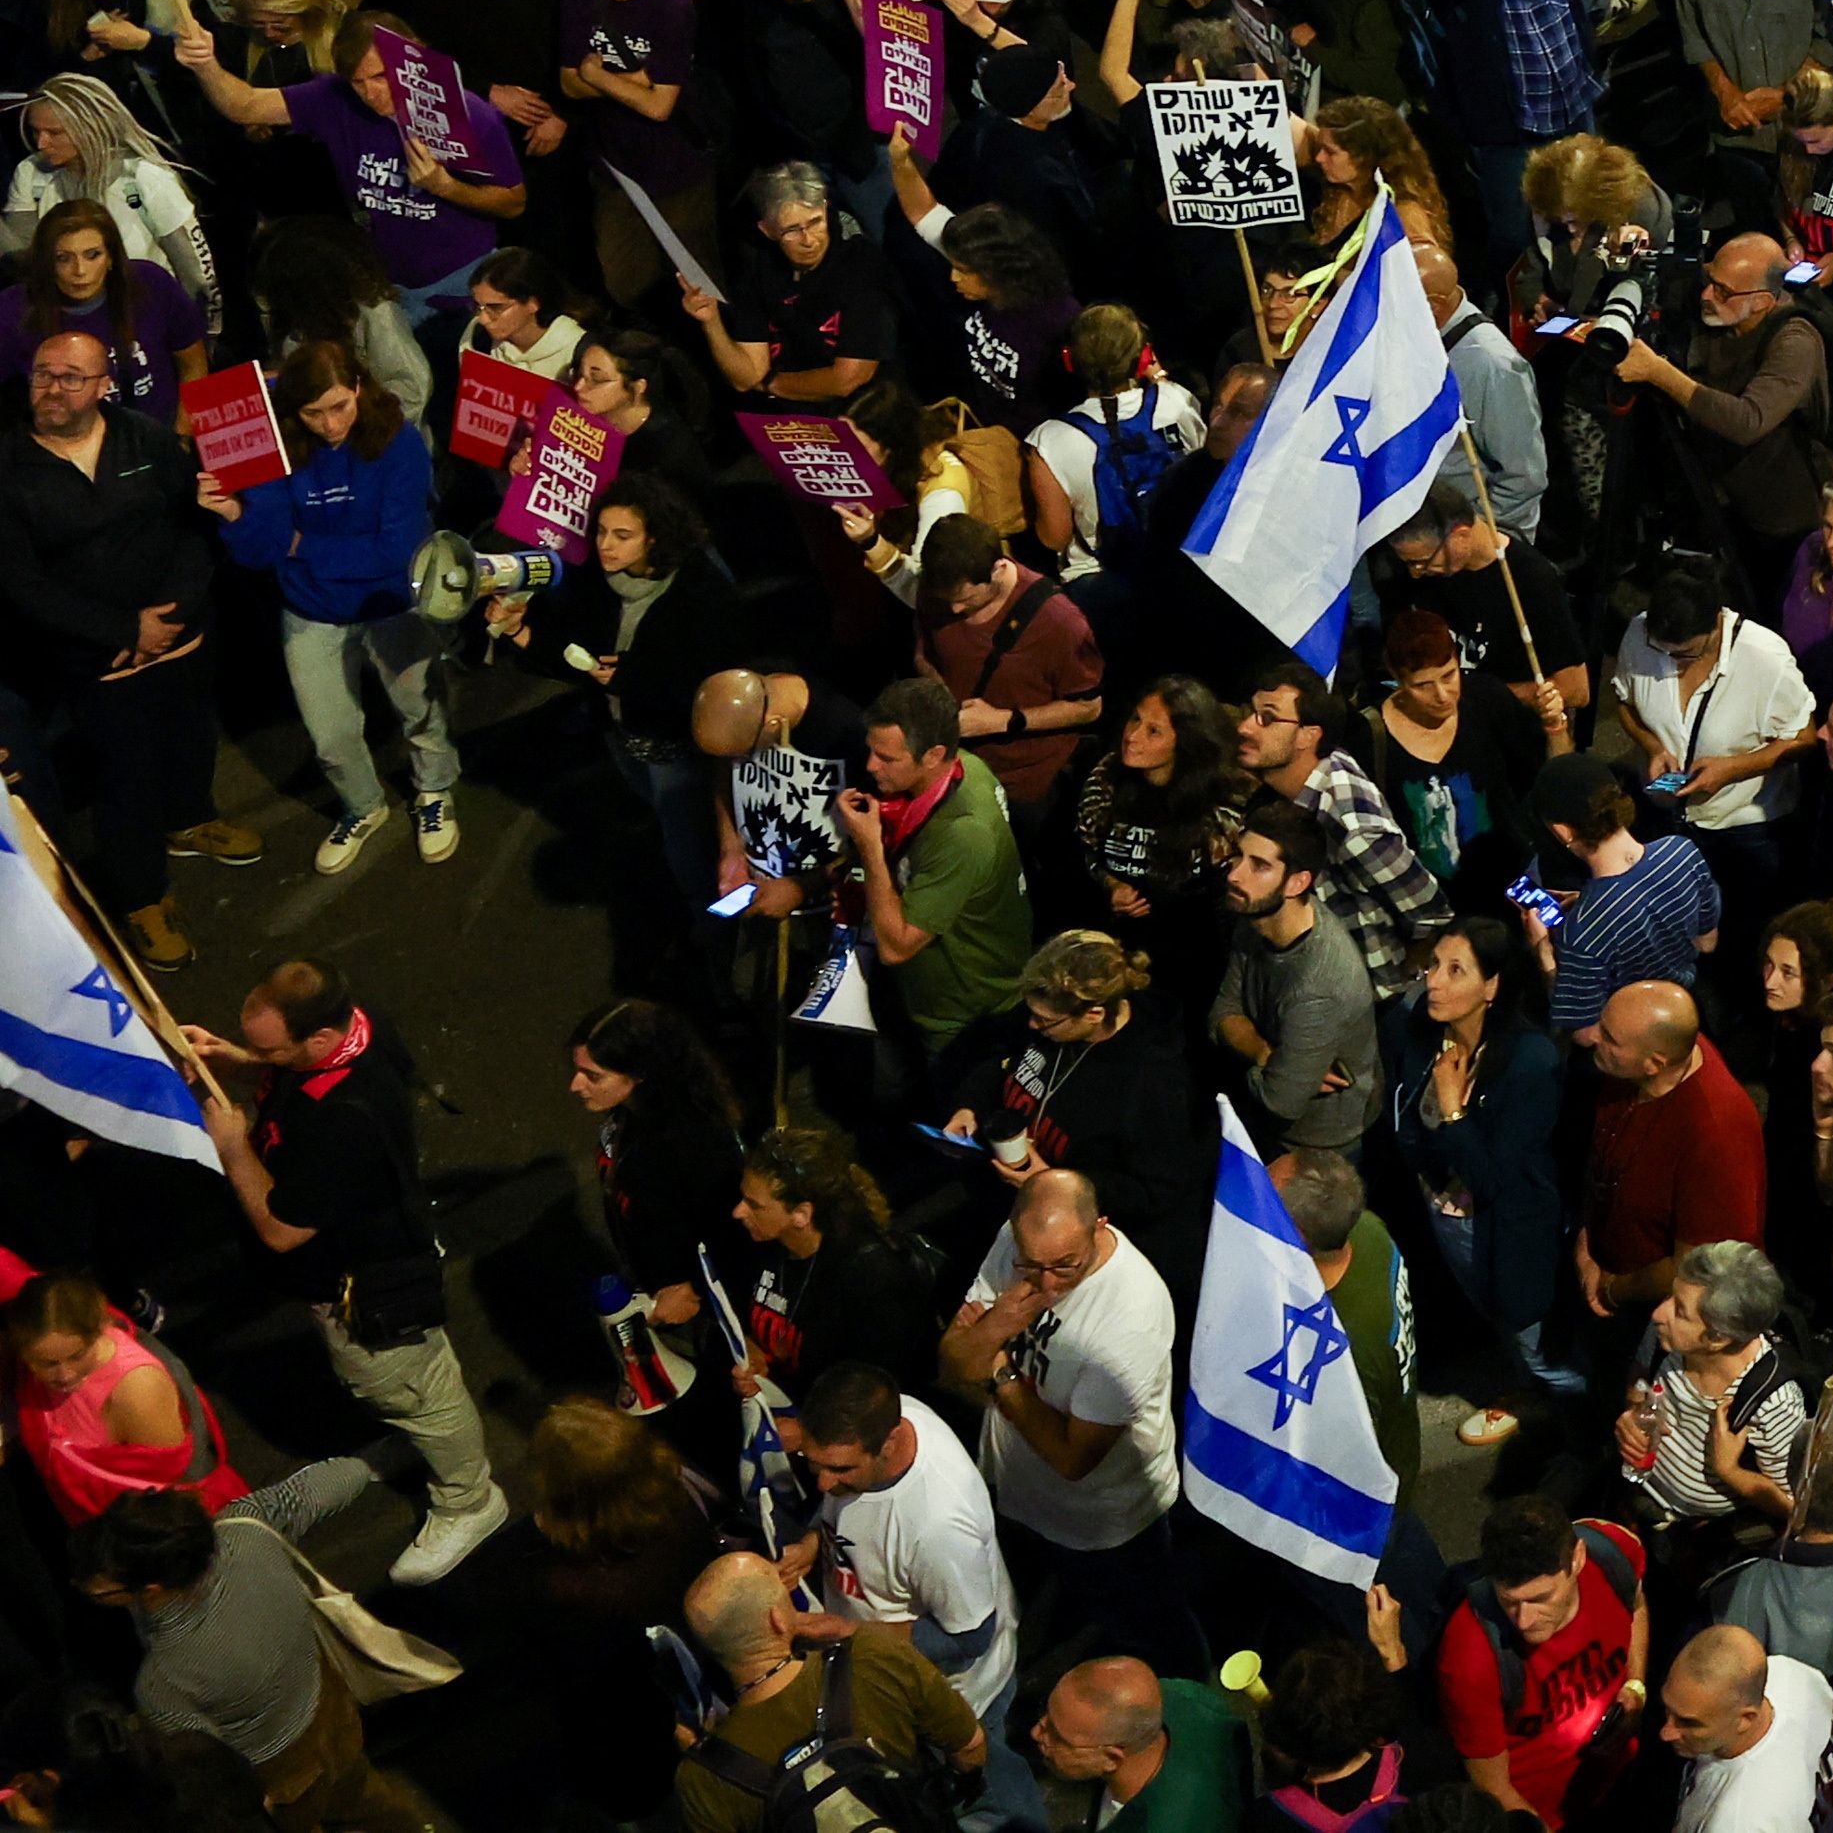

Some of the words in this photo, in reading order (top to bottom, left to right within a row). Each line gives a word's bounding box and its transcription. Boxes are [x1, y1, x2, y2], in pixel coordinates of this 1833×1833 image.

[881, 41, 932, 74] מצילים
[883, 87, 932, 125] חיים
[1158, 86, 1235, 111] שהרס
[1253, 86, 1280, 110] מי
[1160, 110, 1222, 136] יתקן
[1231, 109, 1278, 132] לא
[1177, 200, 1240, 221] עכשיו!
[1242, 198, 1297, 220] בחירות
[539, 444, 597, 492] מצילים
[778, 448, 854, 468] מצילים
[796, 476, 874, 498] חיים
[526, 487, 591, 537] חיים
